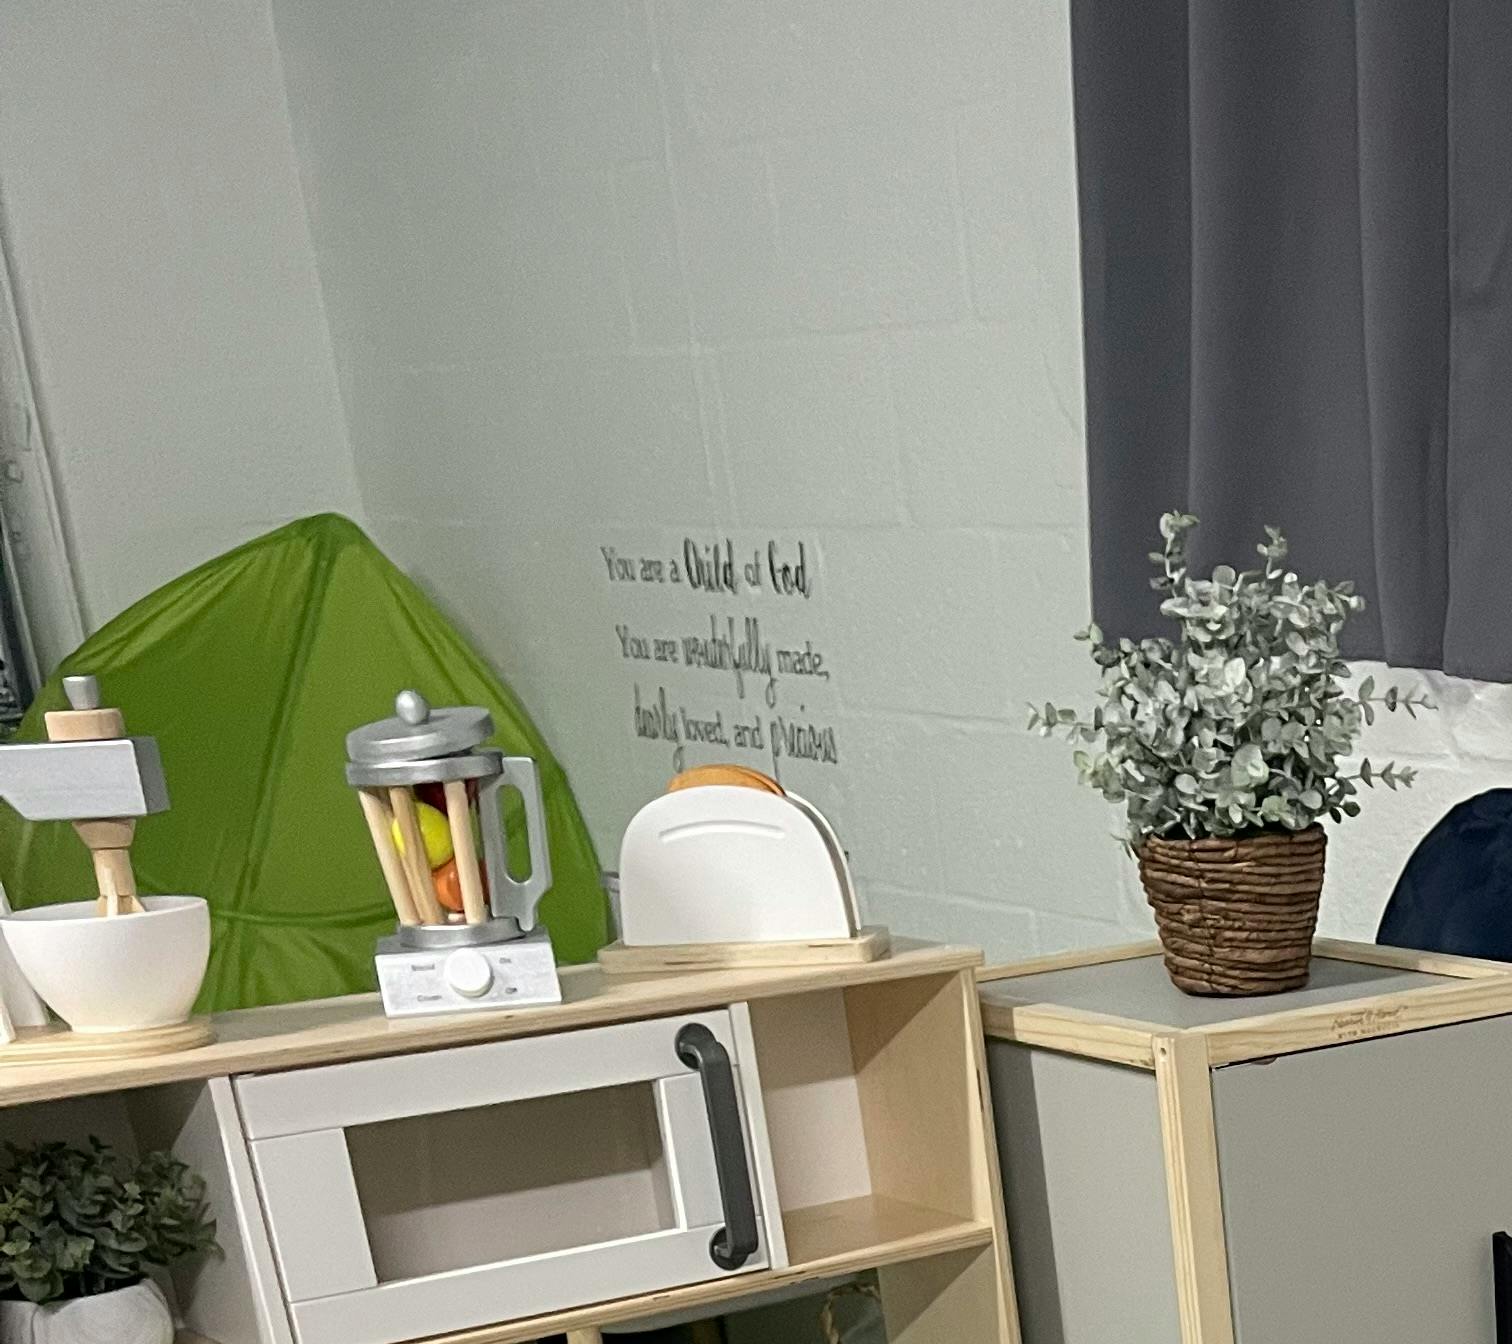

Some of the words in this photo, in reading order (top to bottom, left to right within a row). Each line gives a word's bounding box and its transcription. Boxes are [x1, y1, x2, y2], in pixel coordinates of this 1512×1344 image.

[600, 546, 636, 582] You
[669, 558, 684, 583] a
[768, 540, 812, 600] God
[615, 624, 651, 660] You
